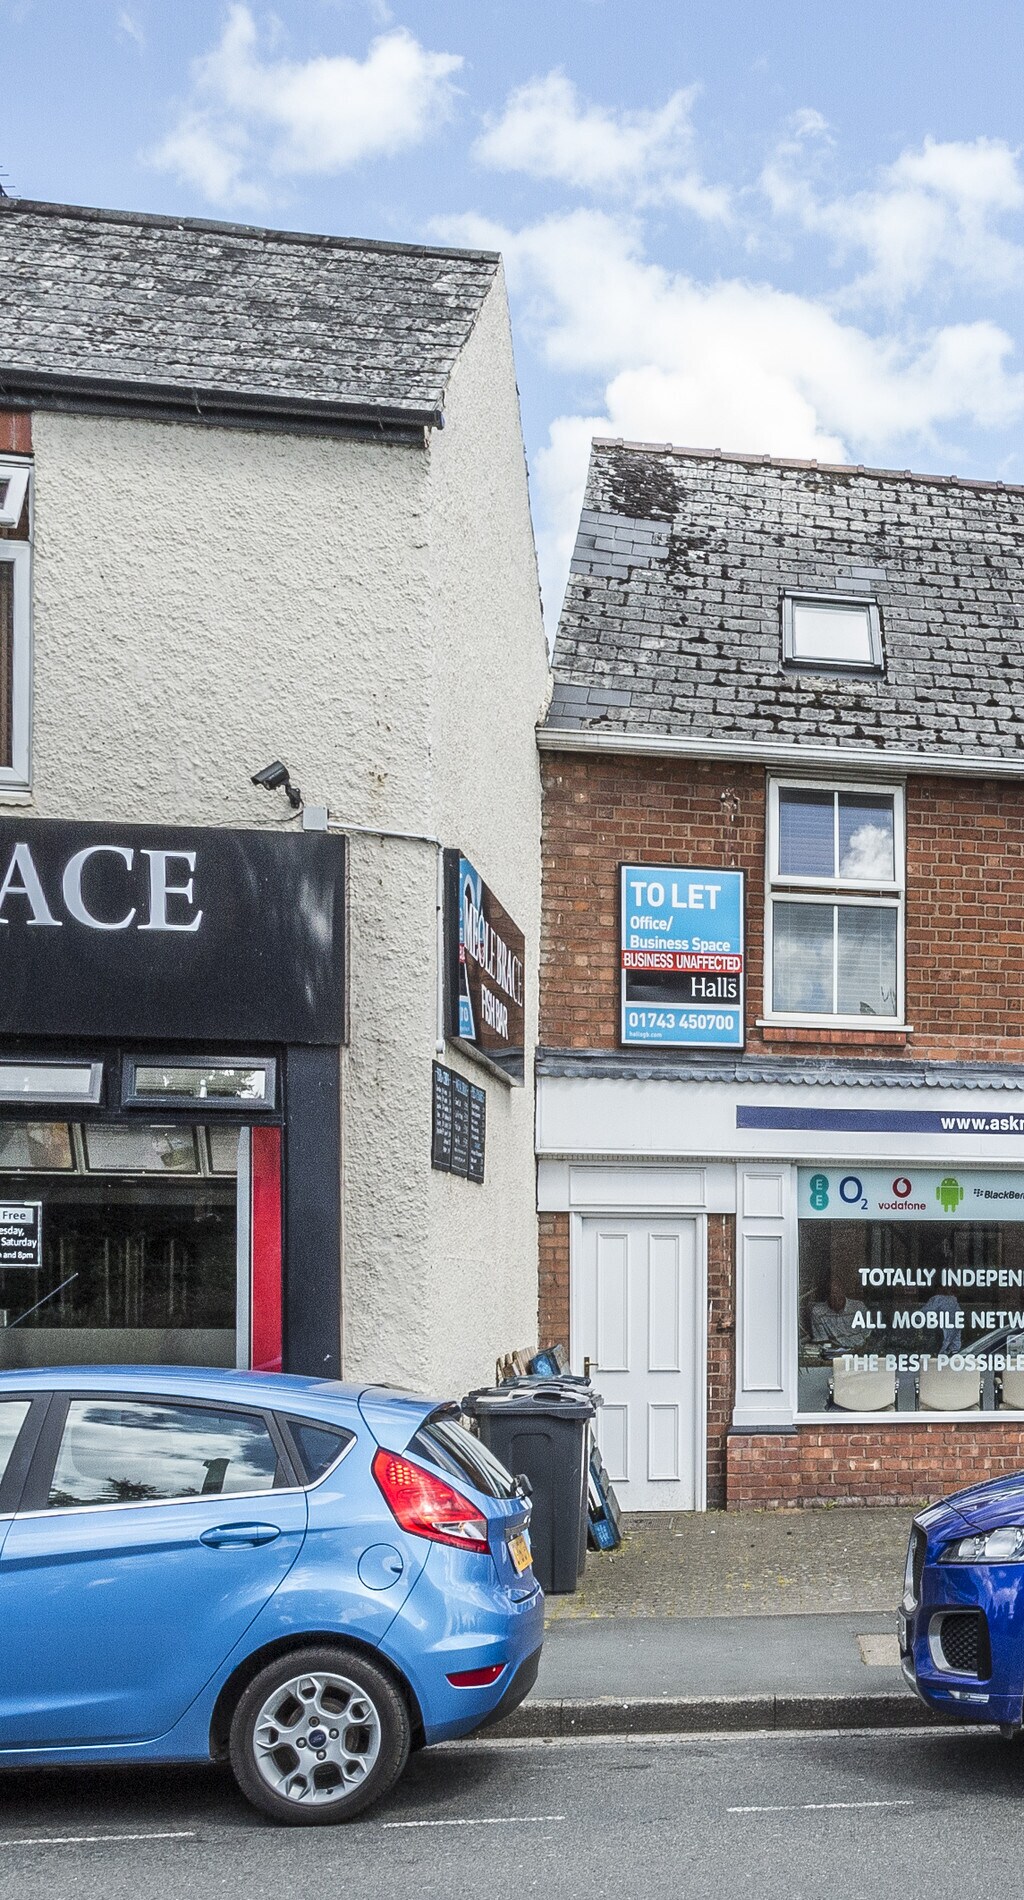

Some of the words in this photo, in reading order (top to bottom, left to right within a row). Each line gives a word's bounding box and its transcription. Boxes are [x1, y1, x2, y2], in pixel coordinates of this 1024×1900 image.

[0, 842, 204, 931] ACE
[630, 881, 665, 908] TO
[671, 883, 722, 910] LET
[630, 916, 674, 932] Office/
[630, 935, 689, 951] Business
[692, 937, 731, 954] Space
[496, 934, 523, 1007] BRACE
[623, 952, 674, 968] BUSINESS
[676, 954, 741, 971] UNAFFECTED
[691, 977, 737, 998] Halls
[481, 983, 495, 1029] FISH
[495, 998, 509, 1040] BAR
[629, 1012, 676, 1029] 01743
[679, 1014, 734, 1031] 450700
[2, 1211, 26, 1220] Free
[878, 1202, 927, 1211] vodafone
[1, 1237, 37, 1249] Saturday
[3, 1251, 17, 1259] and
[17, 1251, 34, 1260] 8pm
[859, 1268, 936, 1286] TOTALLY
[851, 1310, 887, 1329] ALL
[892, 1311, 965, 1329] MOBILE
[842, 1354, 879, 1372] THE
[885, 1354, 931, 1372] BEST
